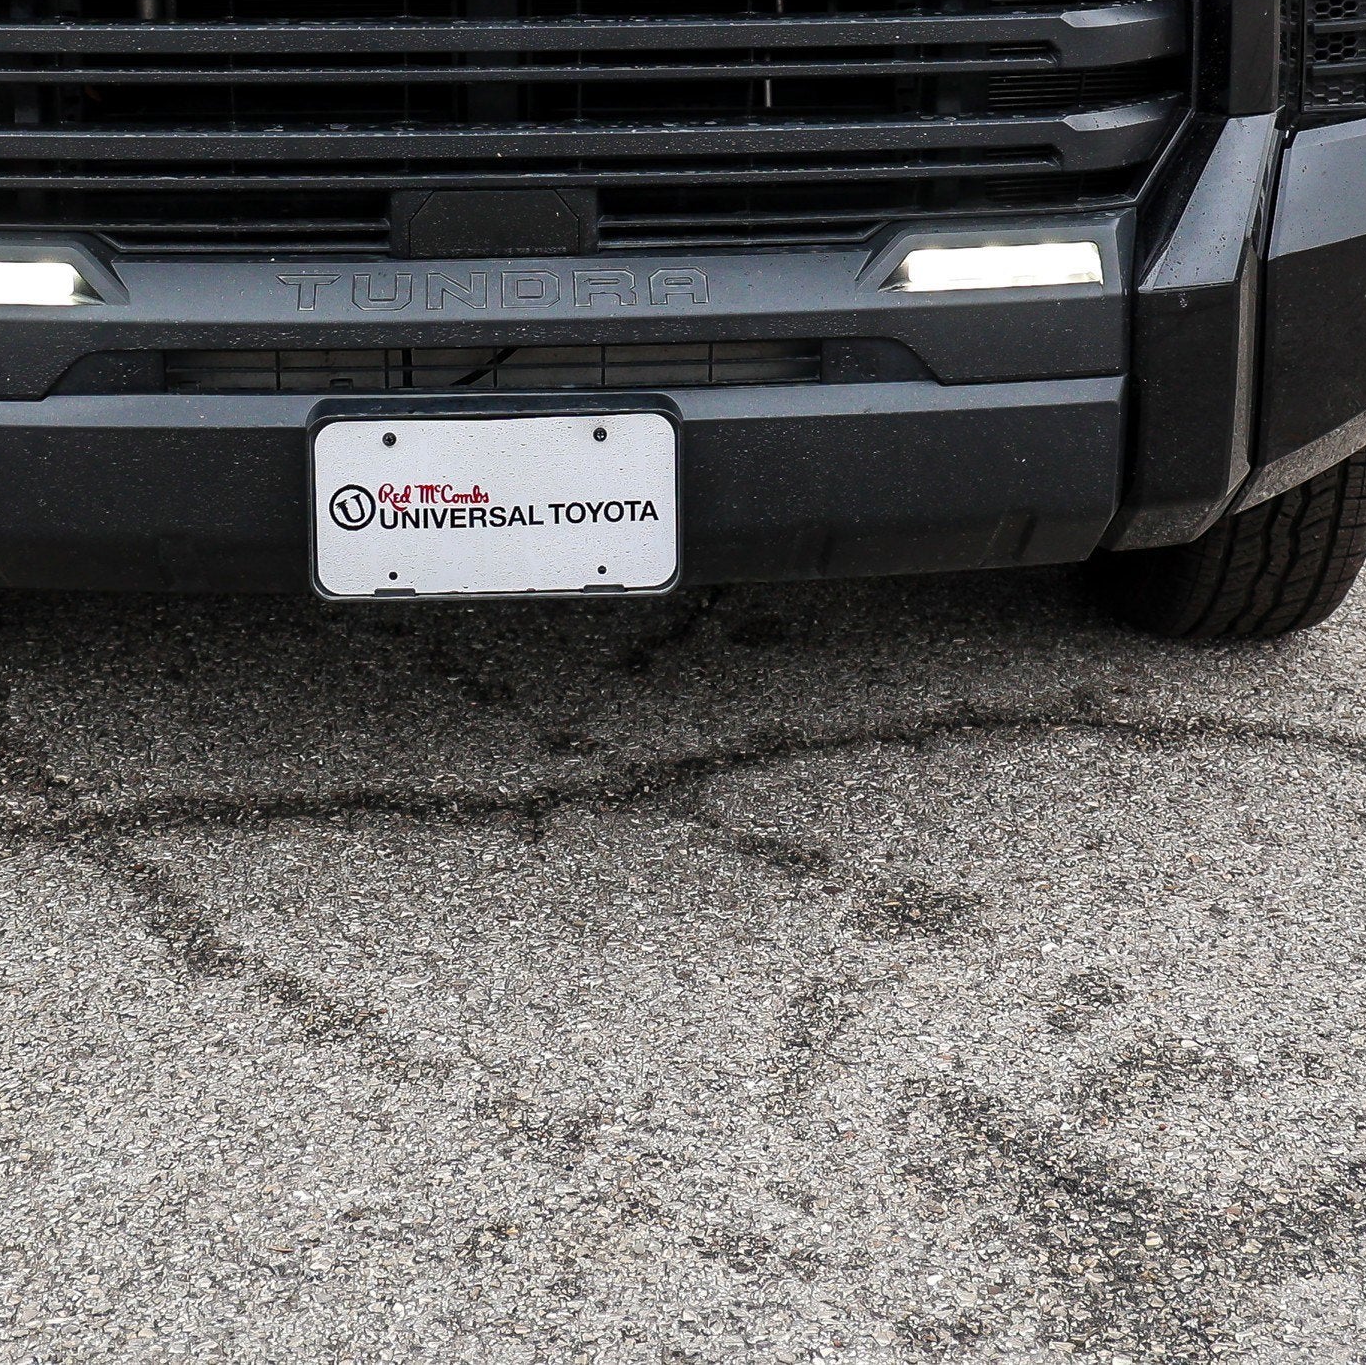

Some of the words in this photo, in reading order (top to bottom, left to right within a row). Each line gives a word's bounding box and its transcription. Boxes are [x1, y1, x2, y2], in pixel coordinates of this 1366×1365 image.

[275, 267, 710, 311] TUNDRA
[378, 483, 411, 511] Red
[414, 484, 489, 504] McCombs
[379, 504, 544, 530] UNIVERSAL
[548, 500, 659, 524] TOYOTA
